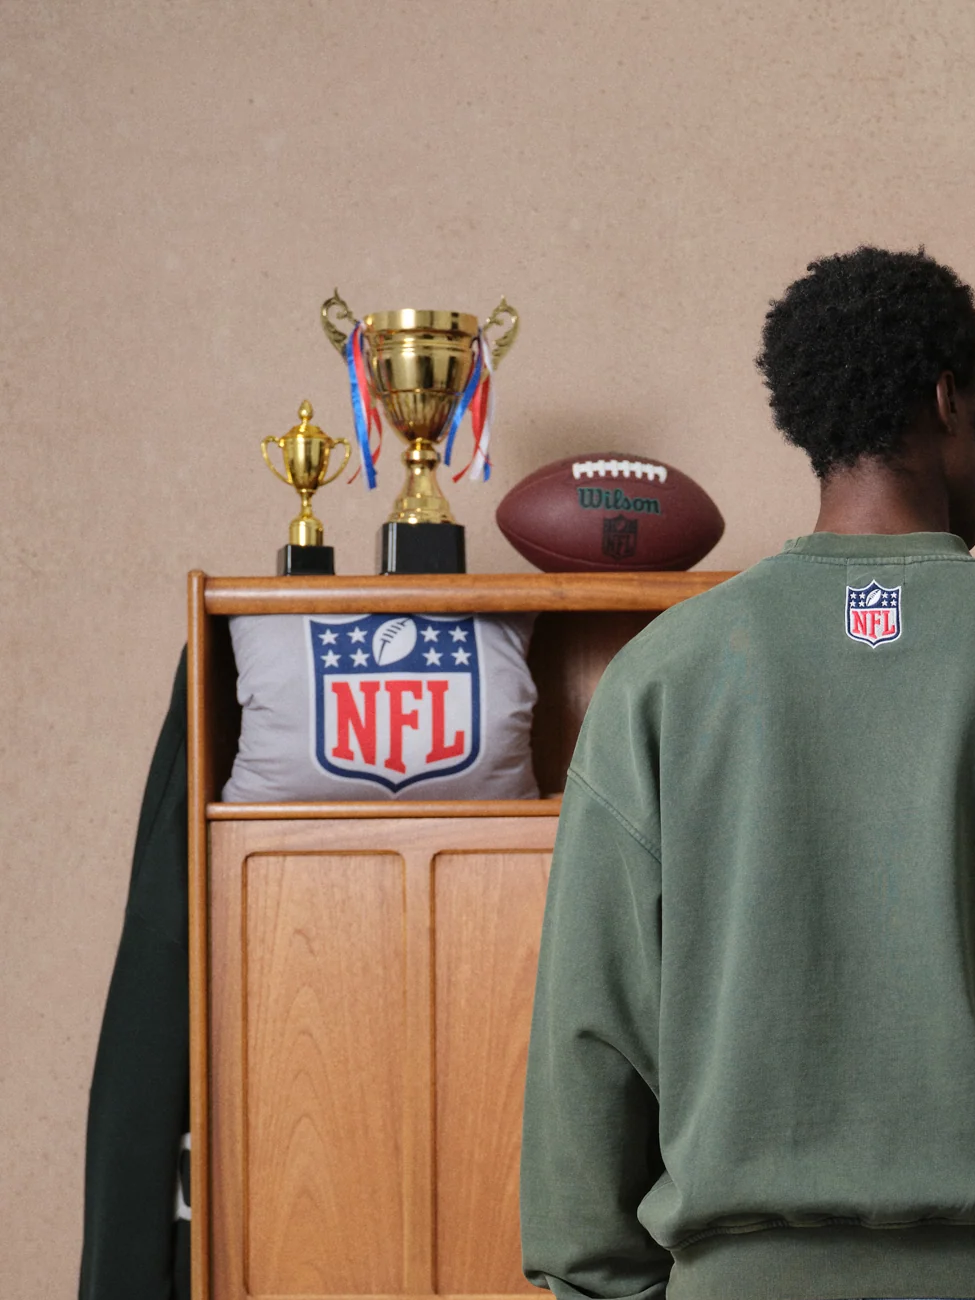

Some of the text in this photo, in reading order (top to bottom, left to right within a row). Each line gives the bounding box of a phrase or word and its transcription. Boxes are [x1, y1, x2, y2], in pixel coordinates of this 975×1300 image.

[577, 487, 662, 515] Wilson
[851, 610, 896, 639] NFL
[331, 680, 465, 774] NFL
